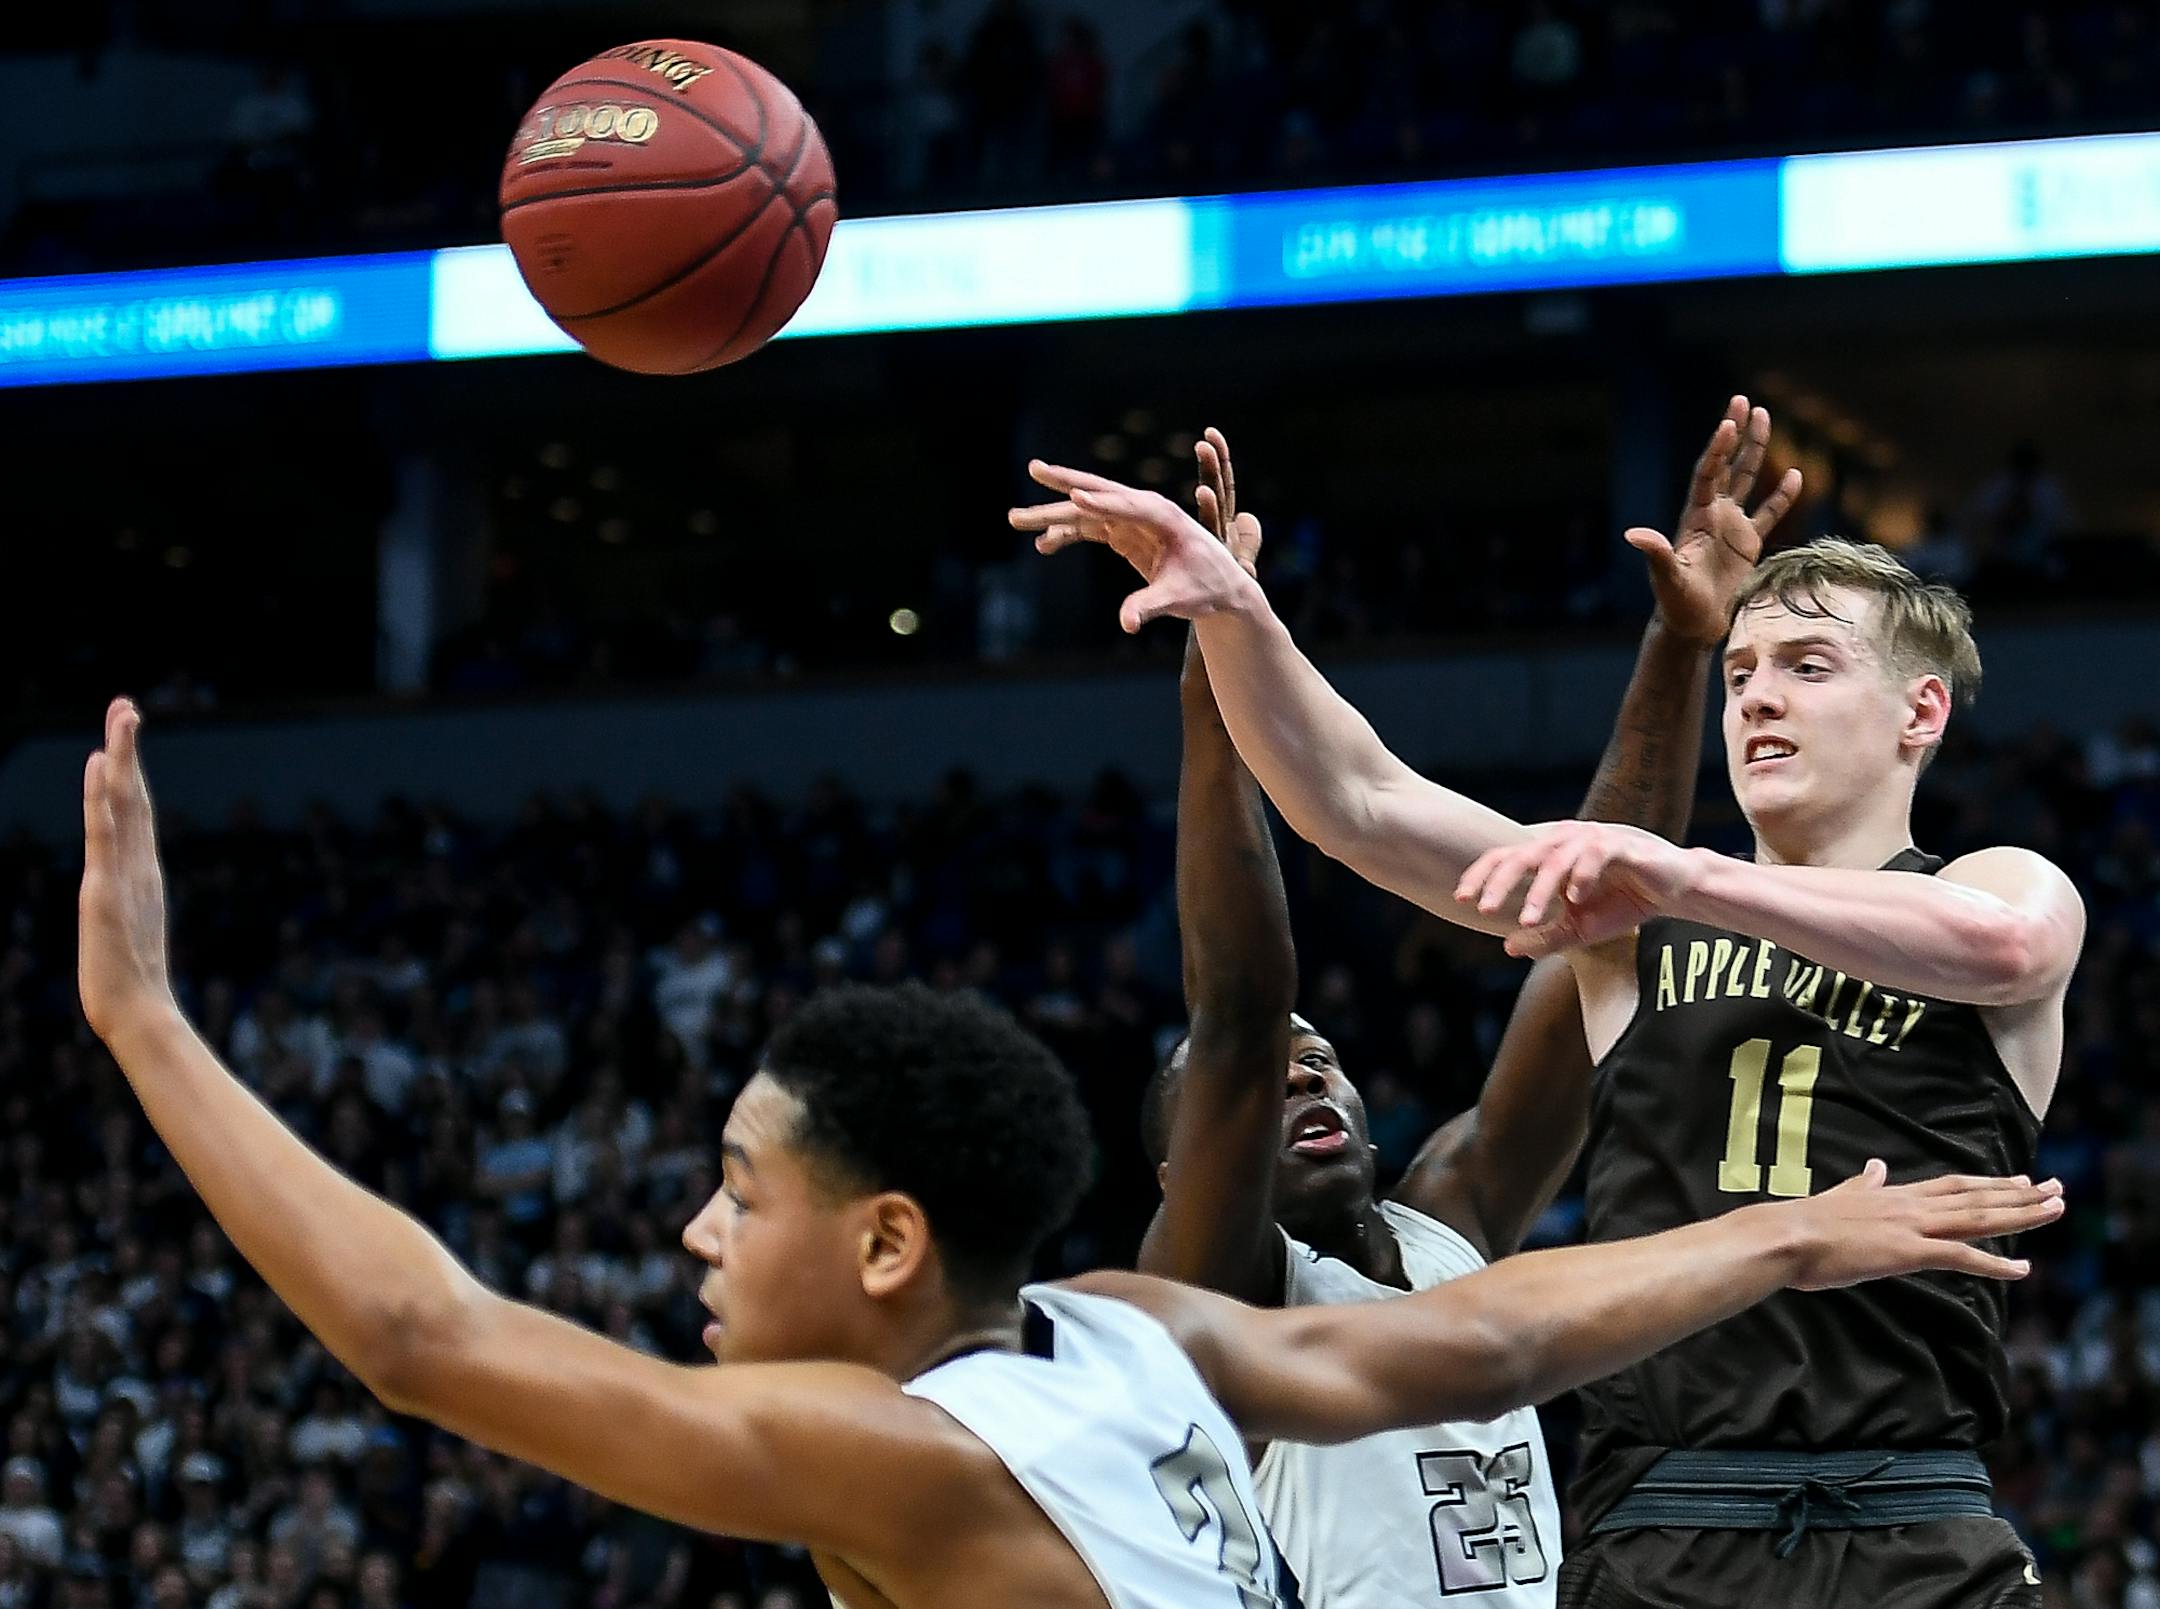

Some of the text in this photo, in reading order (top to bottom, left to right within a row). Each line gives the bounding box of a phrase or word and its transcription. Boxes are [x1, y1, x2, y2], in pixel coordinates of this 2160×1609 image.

[1656, 938, 1926, 1052] APPLE VALLEY
[1717, 1038, 1823, 1197] 11
[1415, 1441, 1549, 1597] 25
